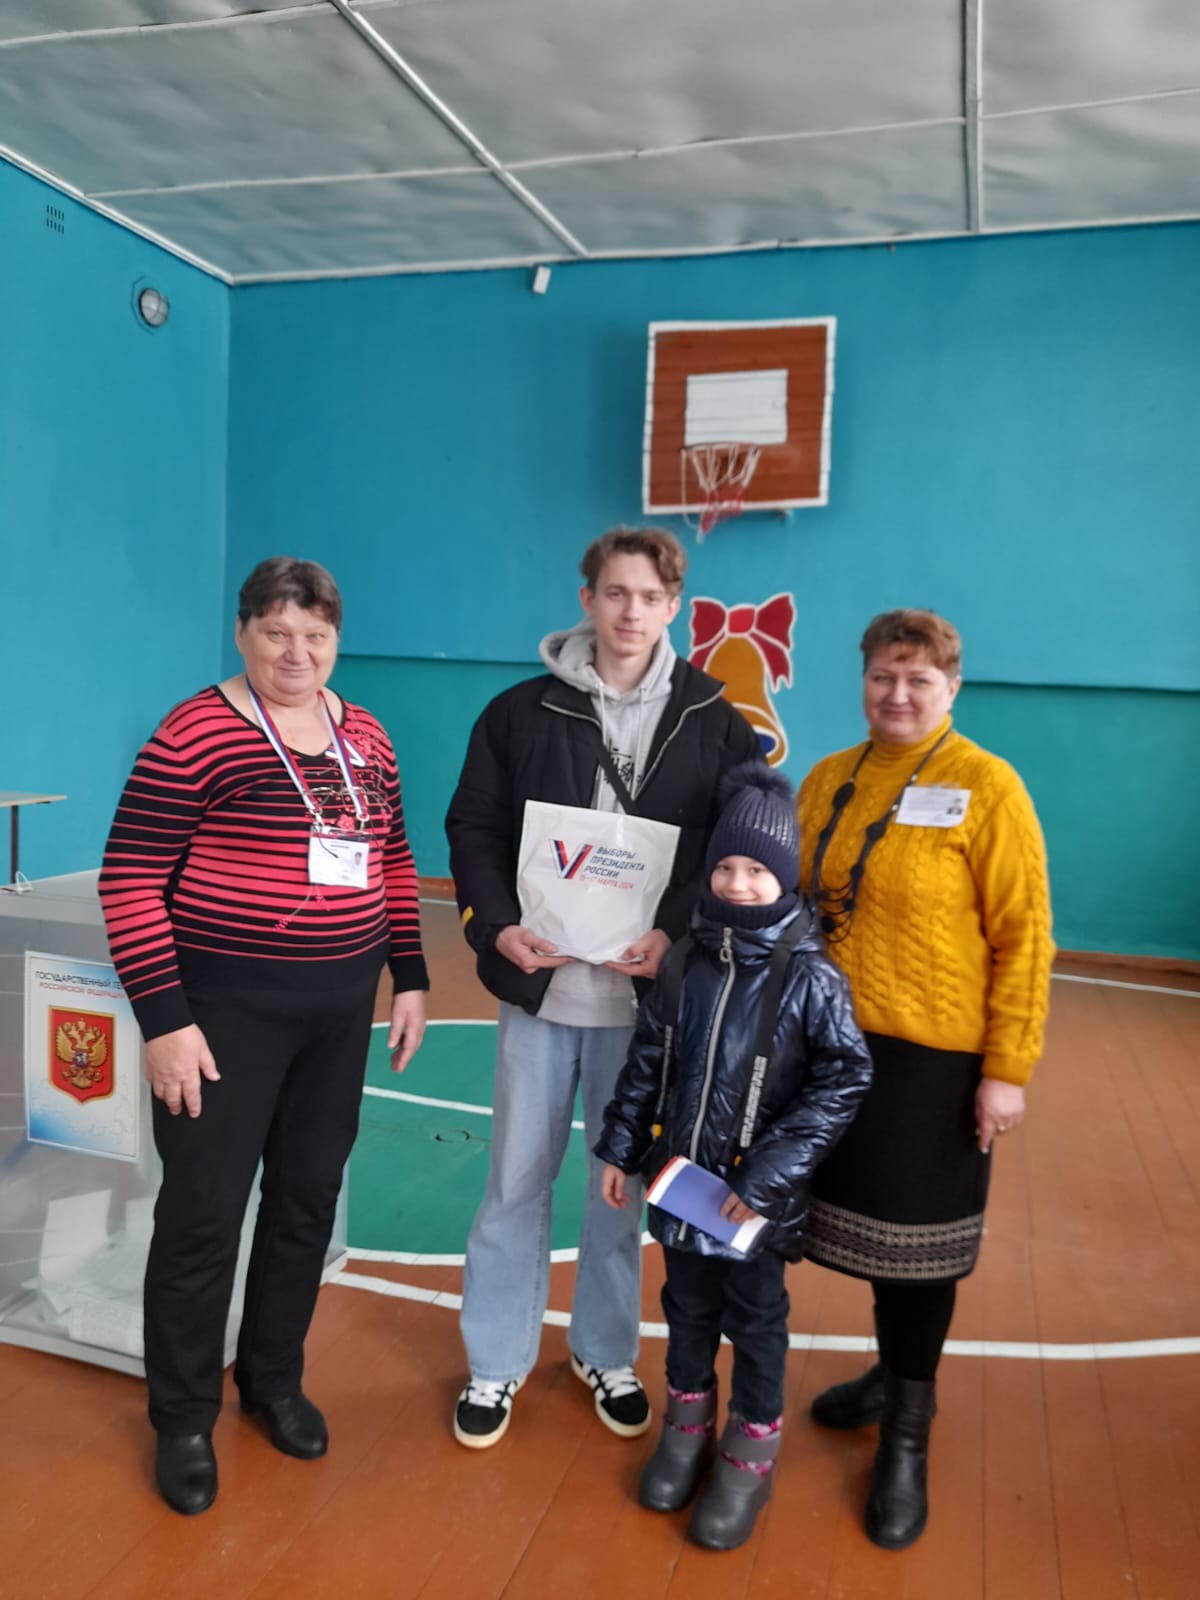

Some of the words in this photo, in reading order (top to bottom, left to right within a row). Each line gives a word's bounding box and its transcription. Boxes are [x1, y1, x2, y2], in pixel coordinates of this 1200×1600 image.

[597, 846, 636, 859] ВЫБОРЫ
[590, 856, 645, 871] ПРЕЗИДЕНТА
[584, 865, 620, 878] РОССИИ
[35, 971, 111, 987] ГОСУДАРСТВЕННЫЙ
